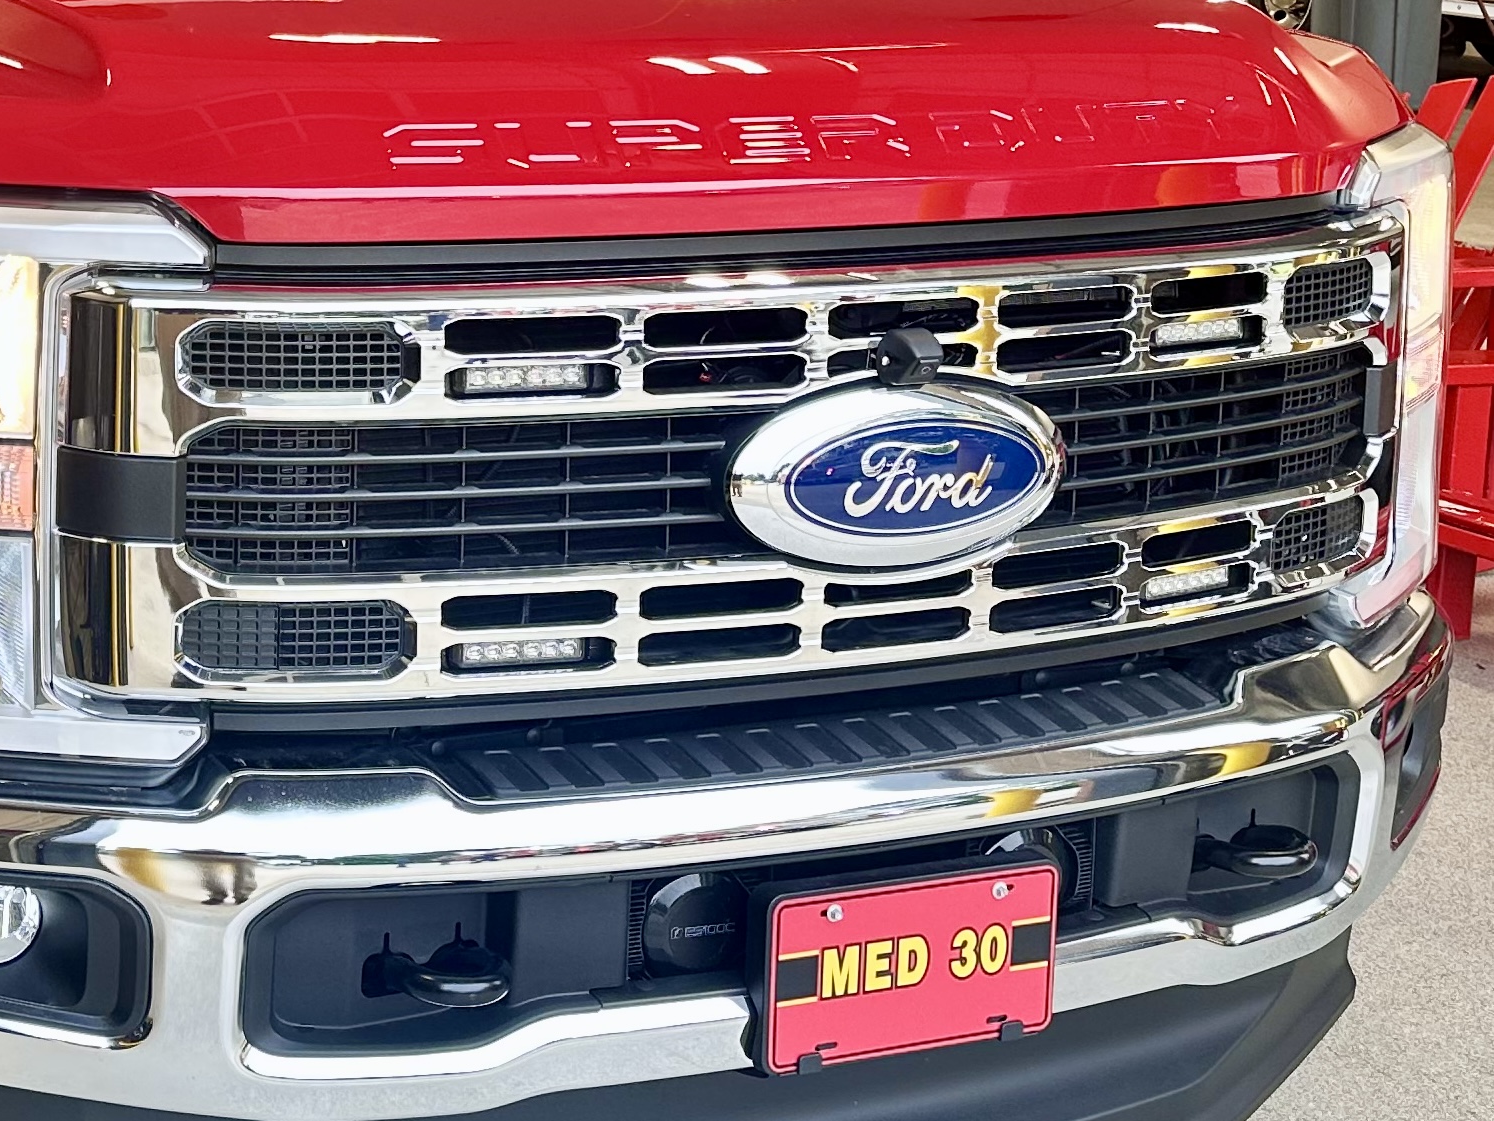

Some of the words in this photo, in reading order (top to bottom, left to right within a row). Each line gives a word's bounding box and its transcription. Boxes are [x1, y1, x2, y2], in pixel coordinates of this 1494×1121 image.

[382, 112, 910, 168] SUPER
[844, 439, 994, 517] Ford
[820, 933, 931, 1000] MED
[949, 922, 1009, 980] 30
